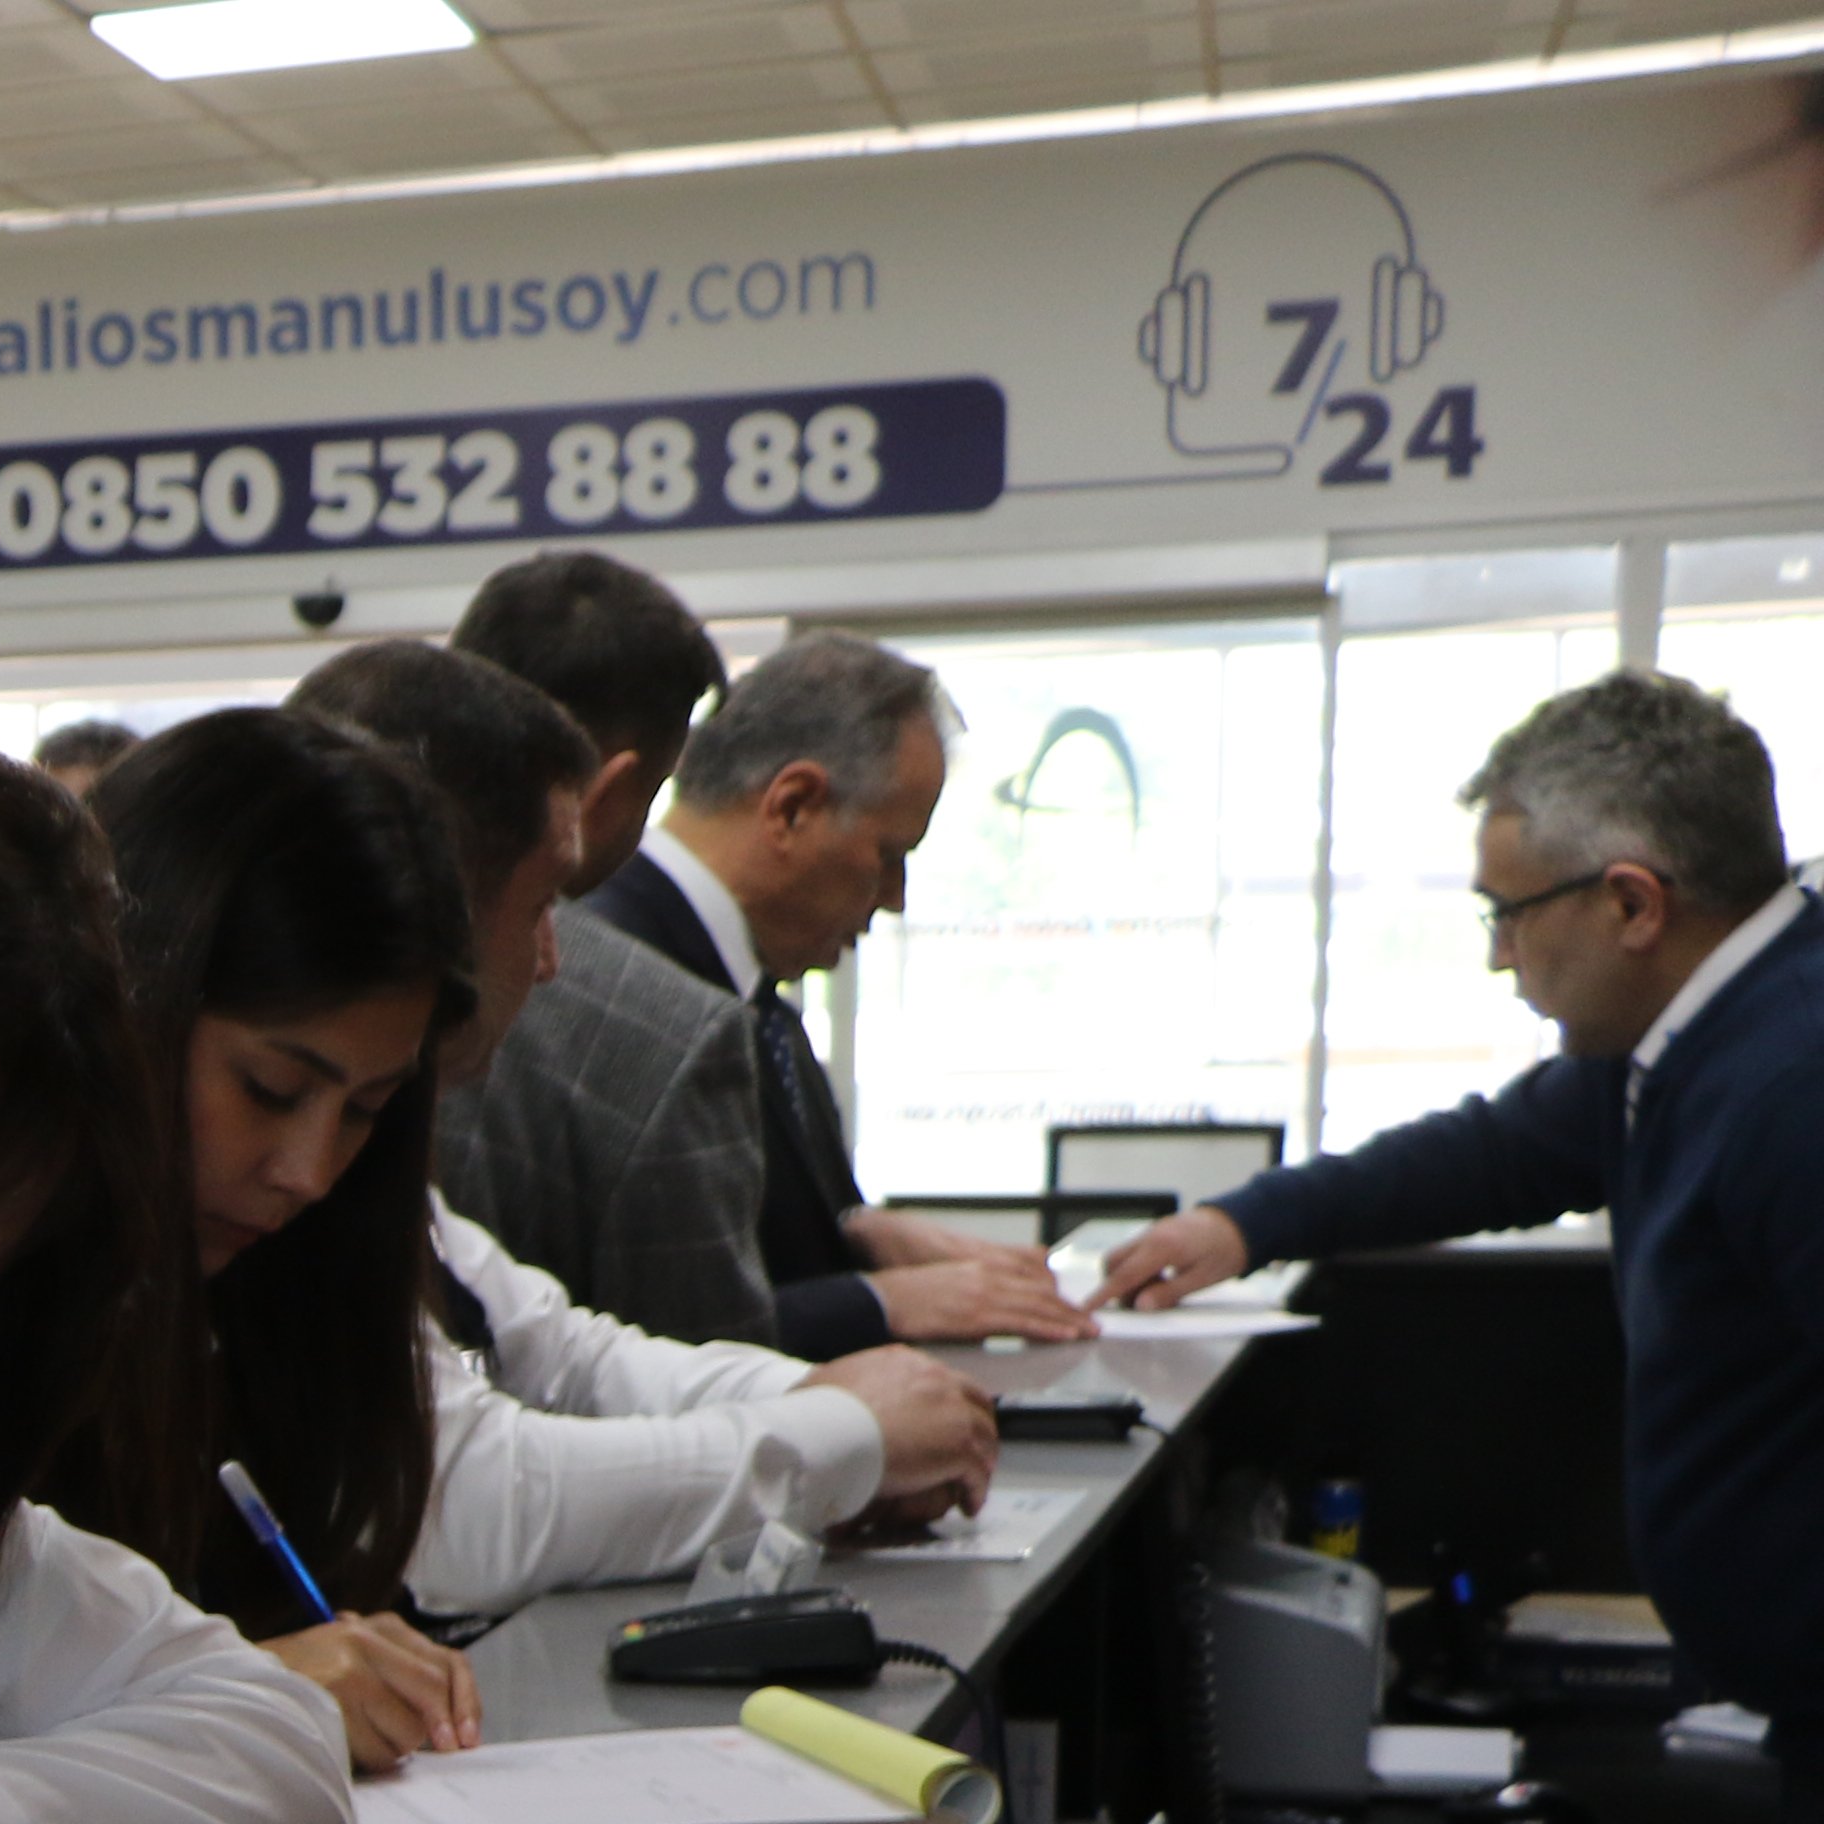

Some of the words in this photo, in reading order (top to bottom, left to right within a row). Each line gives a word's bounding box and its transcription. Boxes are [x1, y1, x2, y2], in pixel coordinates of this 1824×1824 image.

[306, 428, 522, 541] 532
[545, 416, 699, 527] 88
[723, 403, 882, 515] 88
